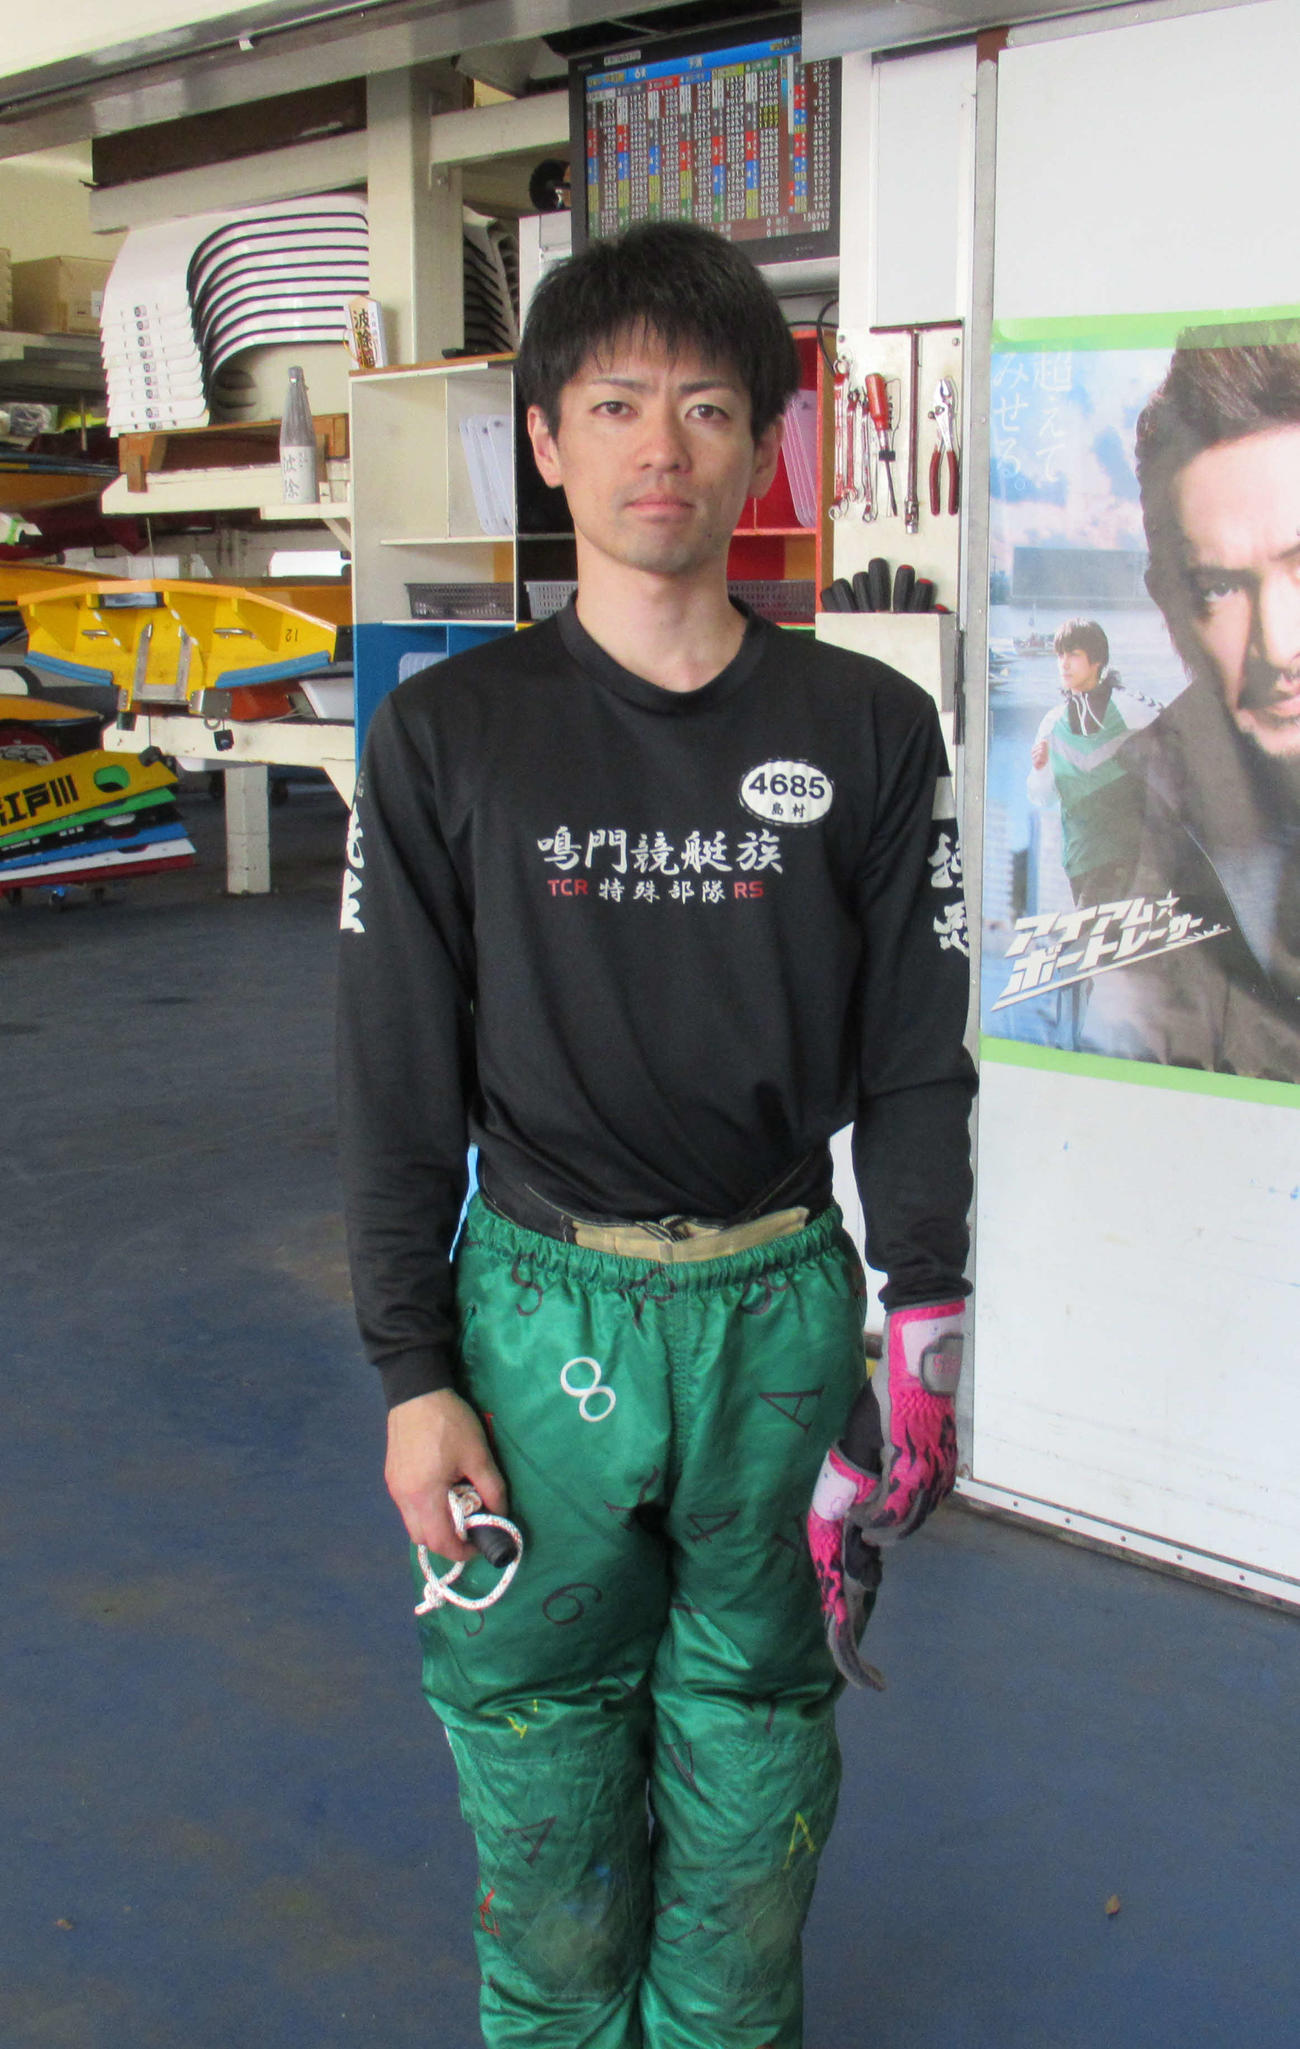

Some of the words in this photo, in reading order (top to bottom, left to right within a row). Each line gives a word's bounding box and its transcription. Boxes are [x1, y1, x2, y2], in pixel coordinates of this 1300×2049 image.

[748, 771, 825, 799] 4685
[772, 802, 806, 818] 島村
[537, 825, 784, 876] 鳴門競艇族
[547, 878, 589, 897] TCR
[599, 877, 727, 905] 特殊部隊
[733, 880, 765, 899] RS
[560, 1357, 616, 1422] 8
